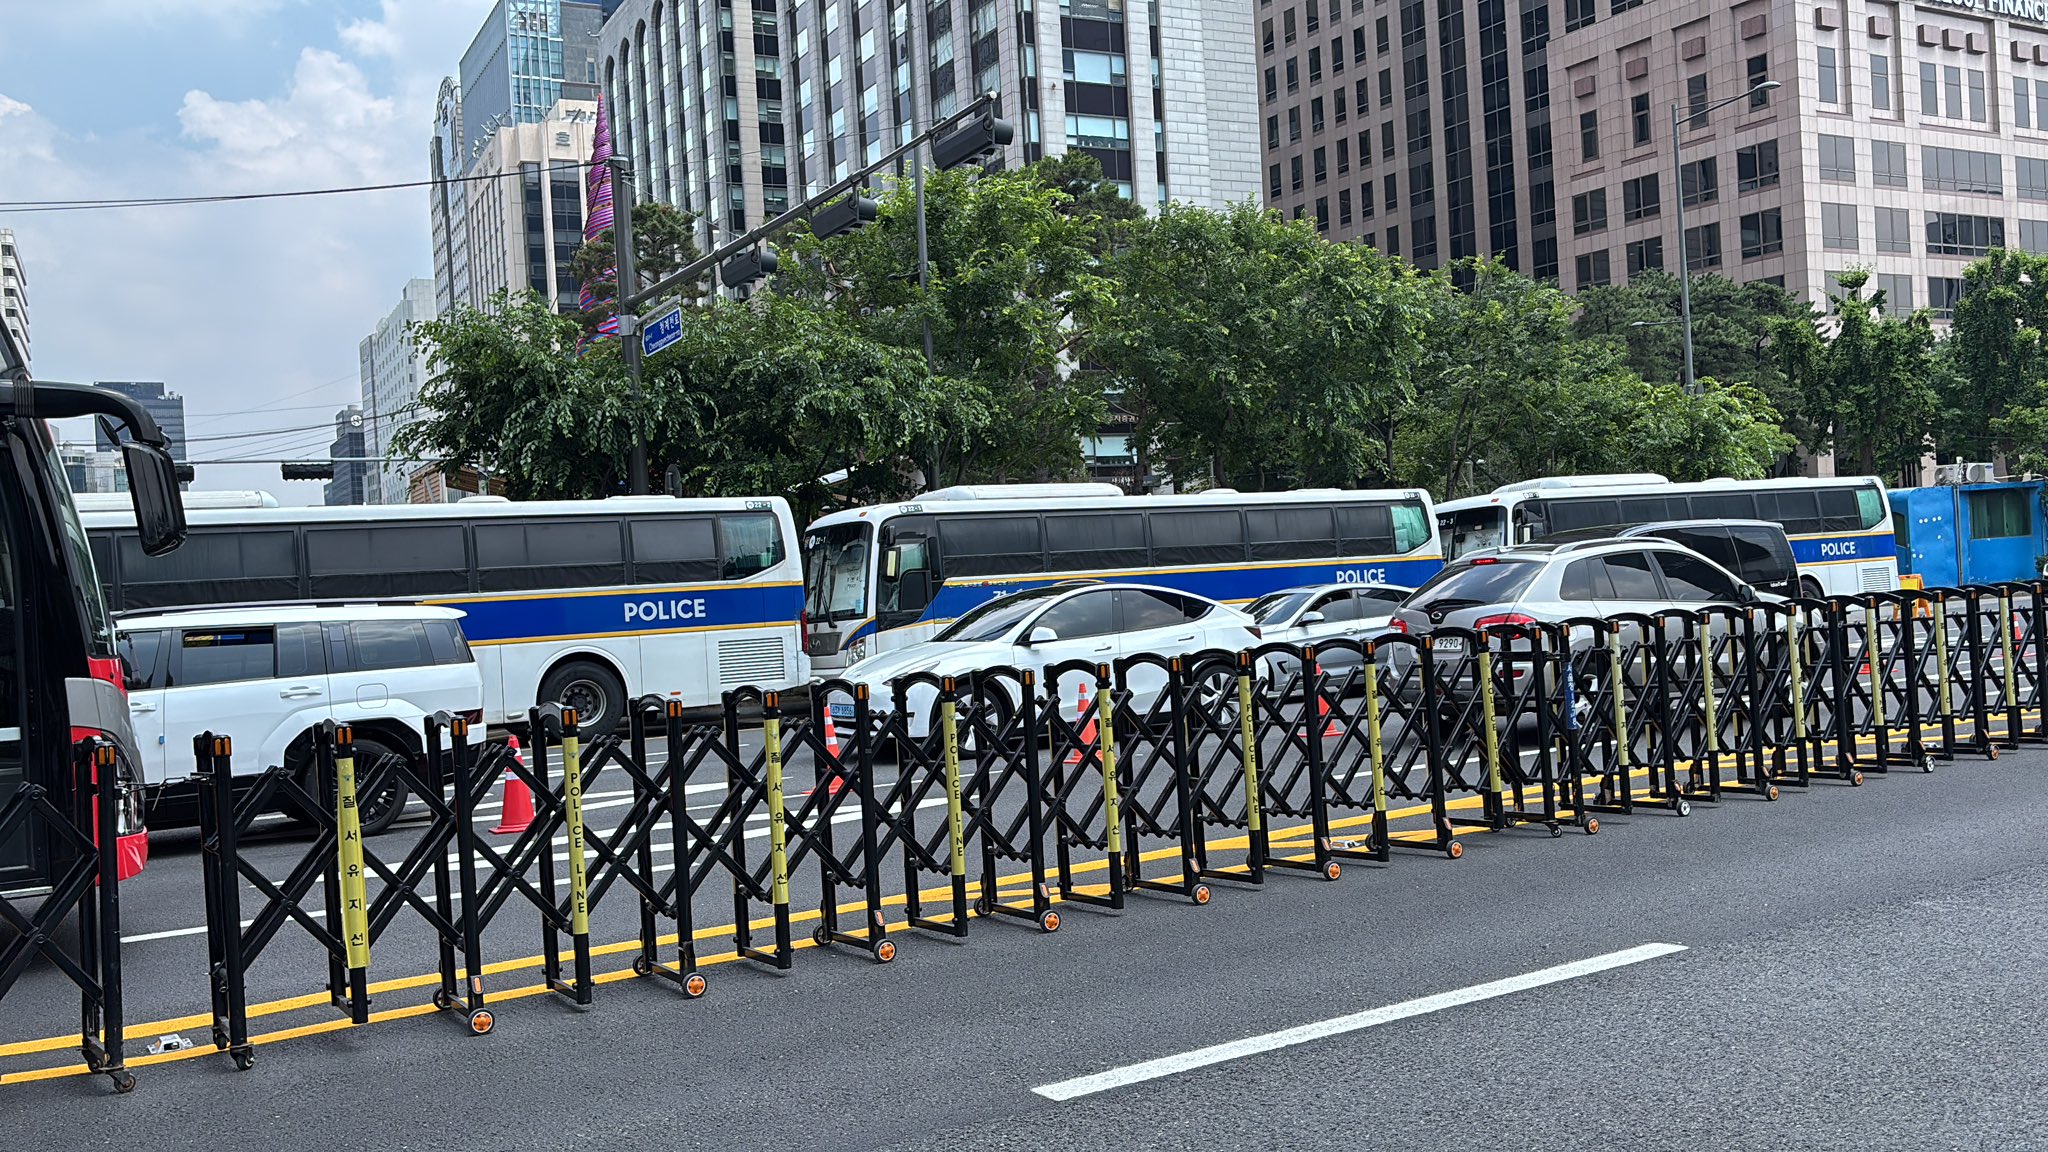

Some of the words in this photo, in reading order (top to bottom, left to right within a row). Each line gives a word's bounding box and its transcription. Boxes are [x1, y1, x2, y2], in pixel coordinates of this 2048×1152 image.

[1336, 568, 1386, 584] POLICE
[1821, 541, 1856, 556] POLICE
[624, 599, 706, 622] POLICE
[1438, 638, 1459, 649] 9290
[1246, 703, 1255, 763] POLICE
[1251, 774, 1259, 813] LINE
[1487, 677, 1497, 731] POLICE
[1493, 742, 1501, 777] LINE
[571, 773, 582, 848] POLICE
[770, 752, 788, 885] 질서유지선
[950, 733, 960, 799] POLICE
[955, 813, 963, 857] LINE
[1104, 717, 1120, 835] 질서유지선
[342, 795, 364, 947] 질서유지선
[576, 864, 585, 913] LINE
